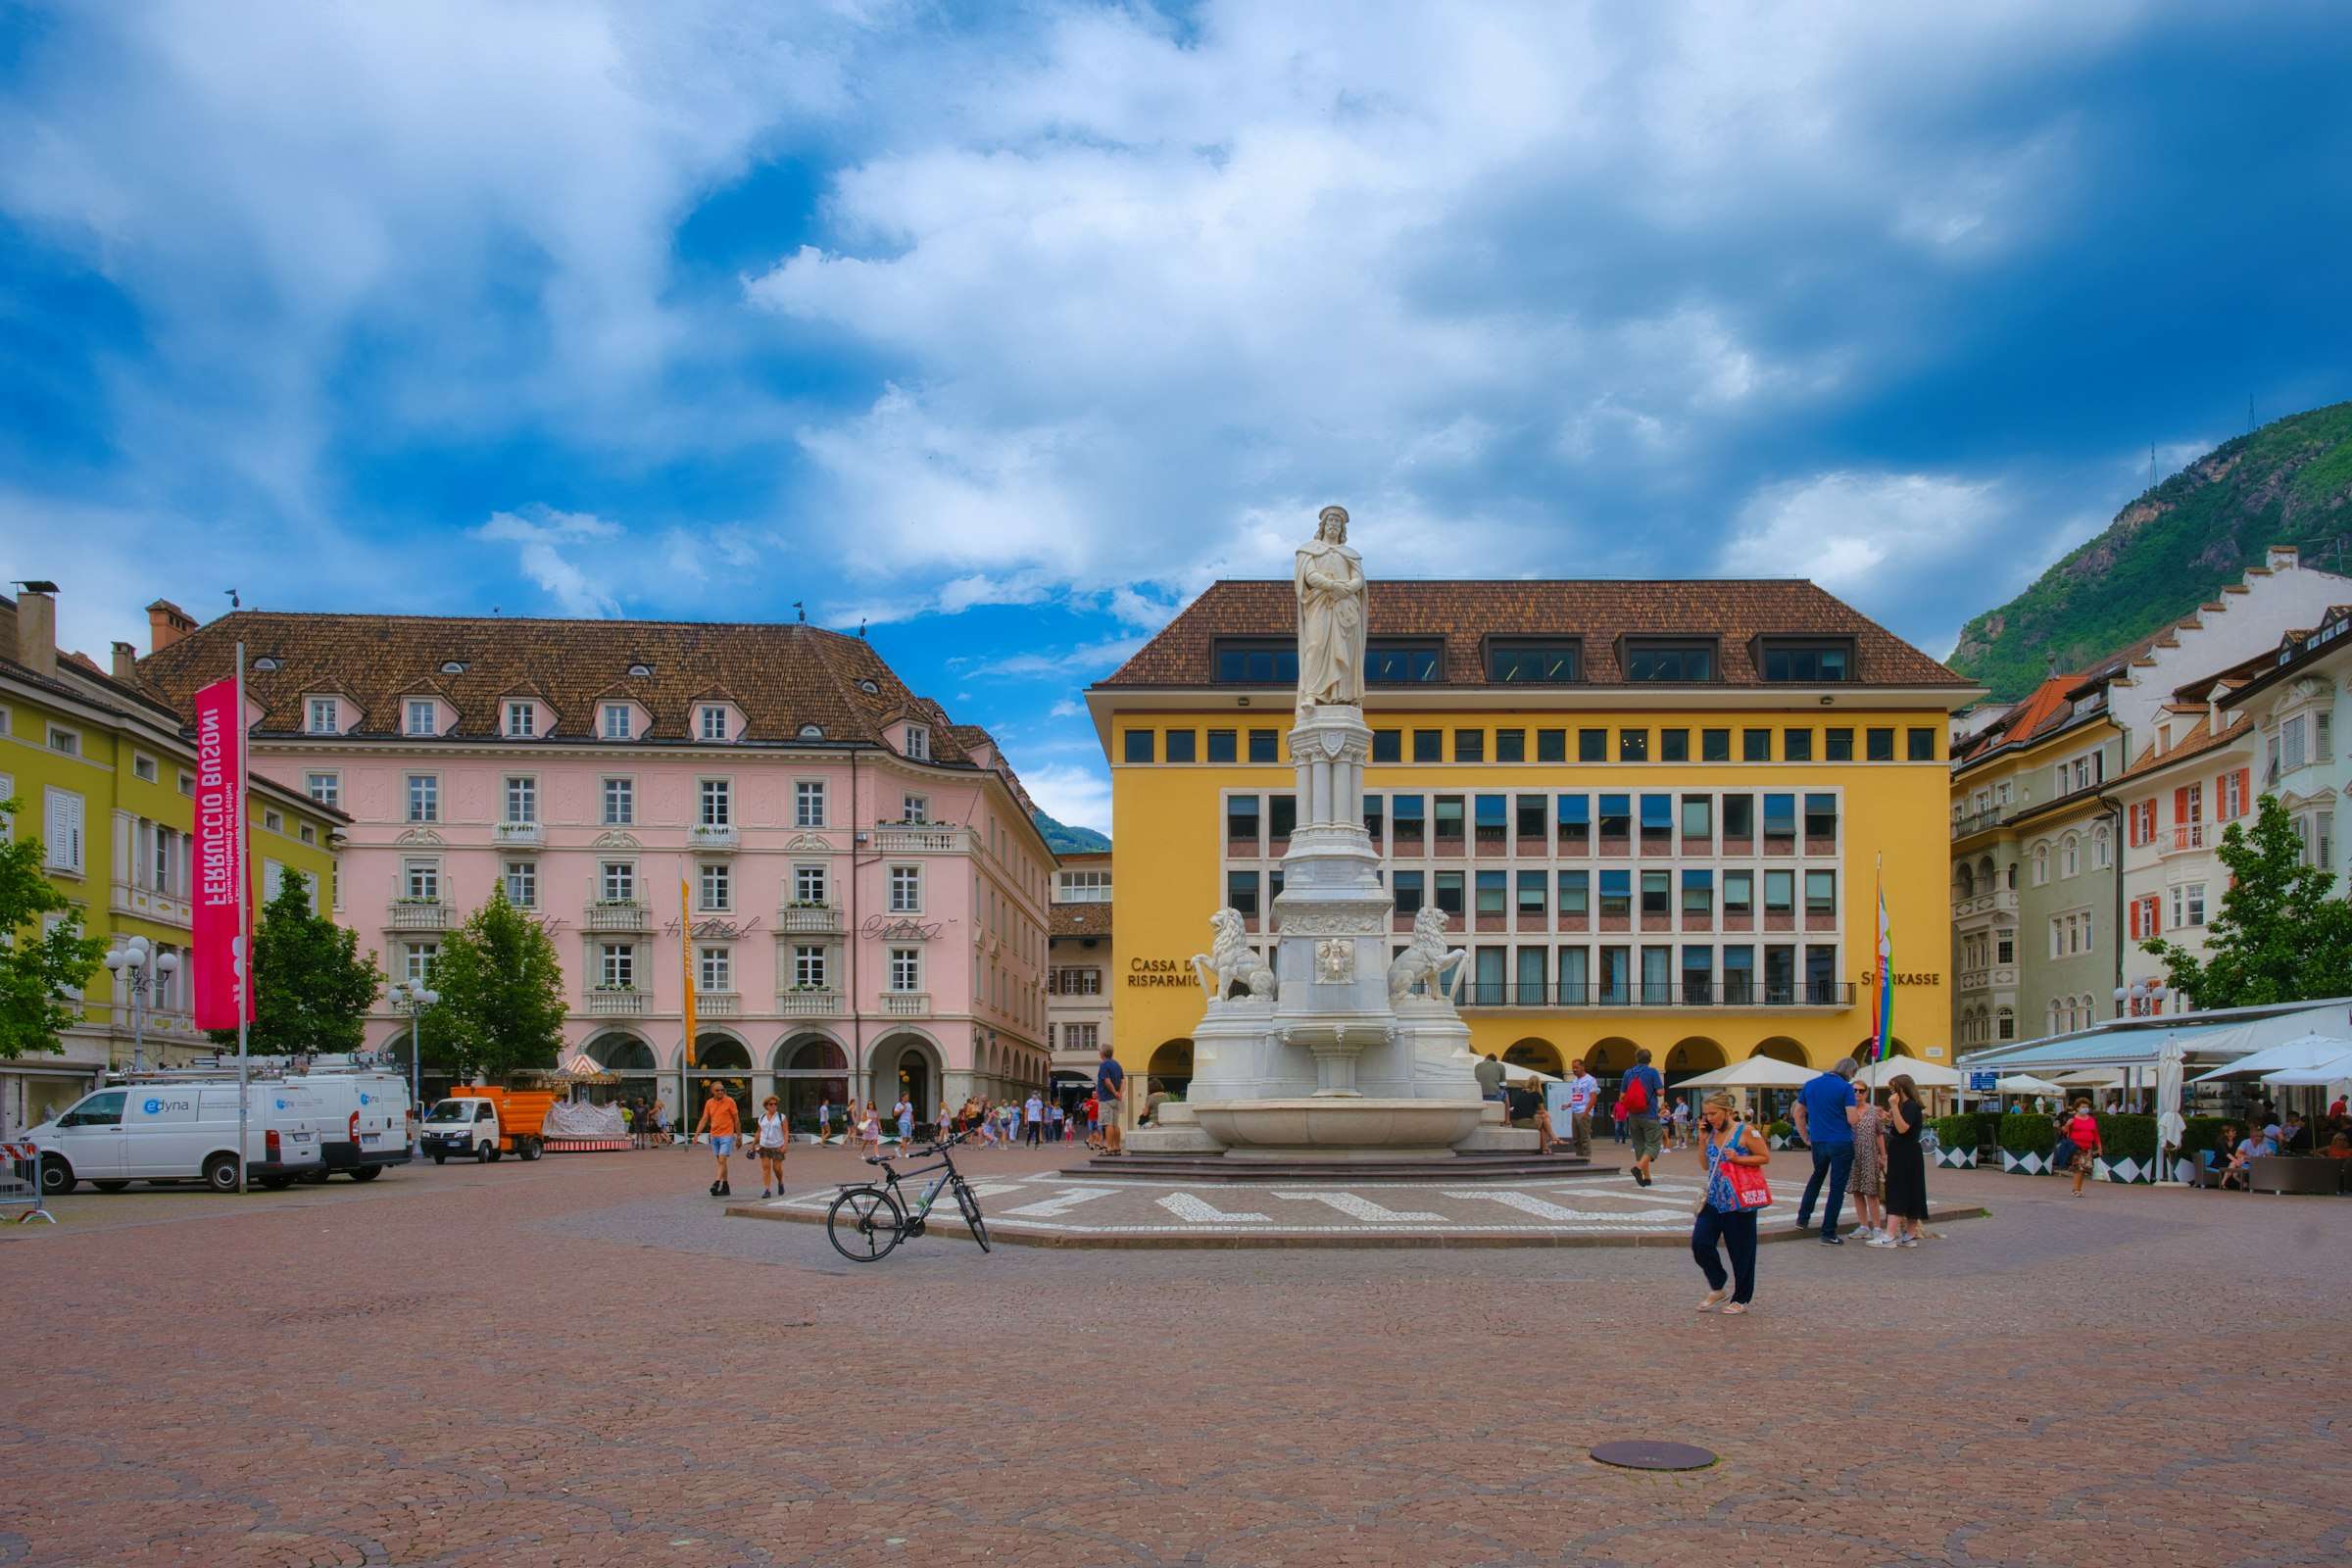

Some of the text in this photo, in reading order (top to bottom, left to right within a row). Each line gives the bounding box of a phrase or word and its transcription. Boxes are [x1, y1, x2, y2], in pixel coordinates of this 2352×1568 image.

[1131, 956, 1176, 972] CASSA
[1128, 975, 1200, 987] RISPARMIO
[1861, 971, 1939, 986] SRKASSE
[145, 1099, 189, 1113] edyna
